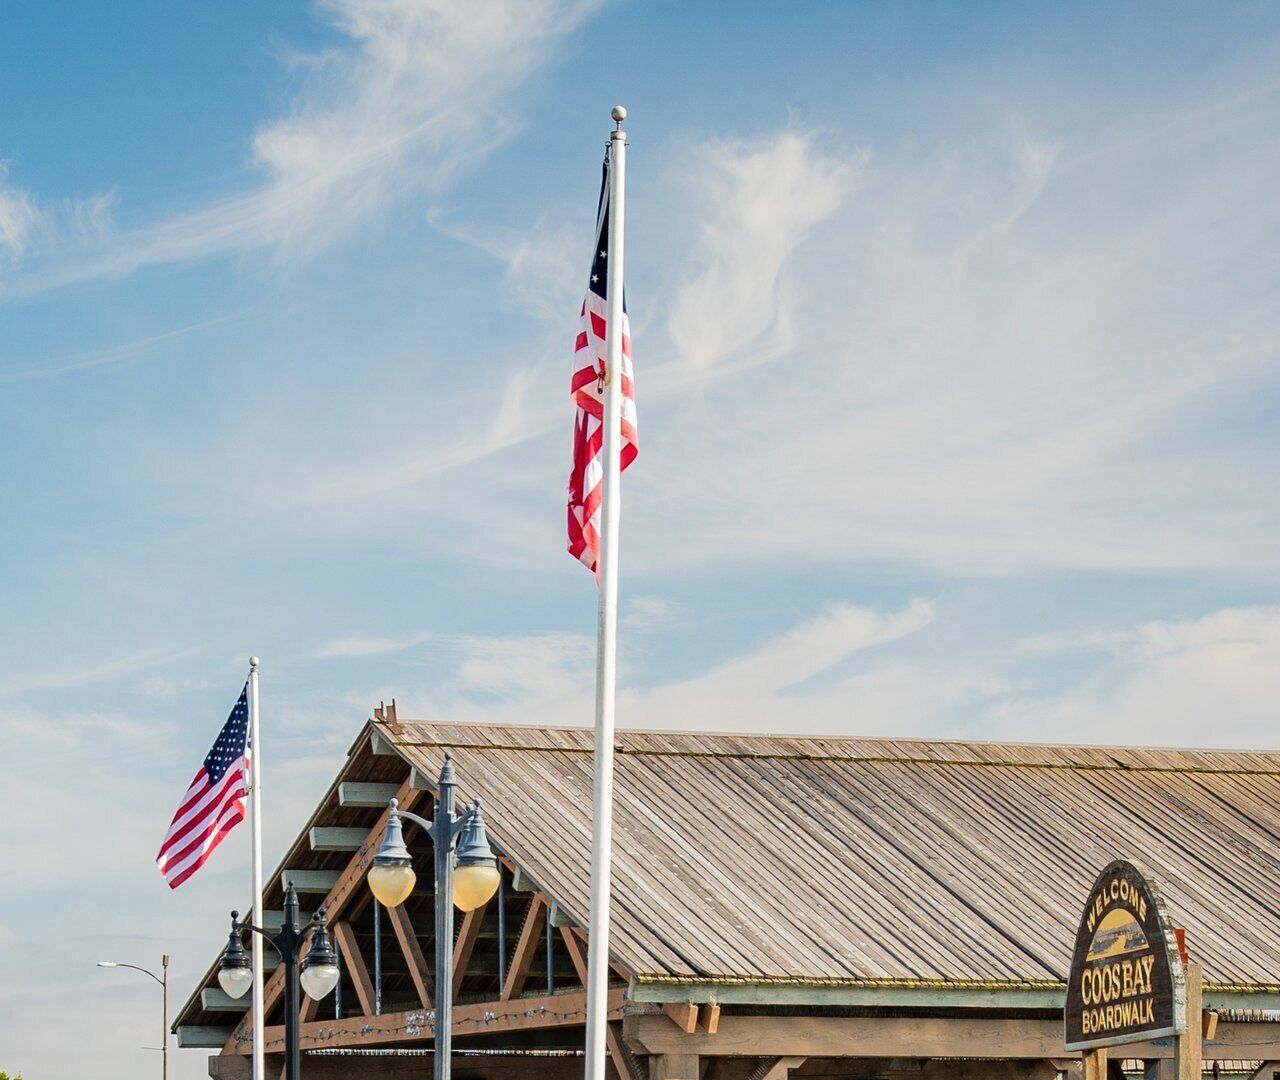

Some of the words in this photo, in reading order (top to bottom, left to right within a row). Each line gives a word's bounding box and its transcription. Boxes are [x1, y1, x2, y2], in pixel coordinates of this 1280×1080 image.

[1087, 878, 1147, 933] WELCOME
[1081, 963, 1120, 1005] COOS
[1122, 955, 1155, 997] BAY
[1082, 997, 1155, 1034] BOARDWALK
